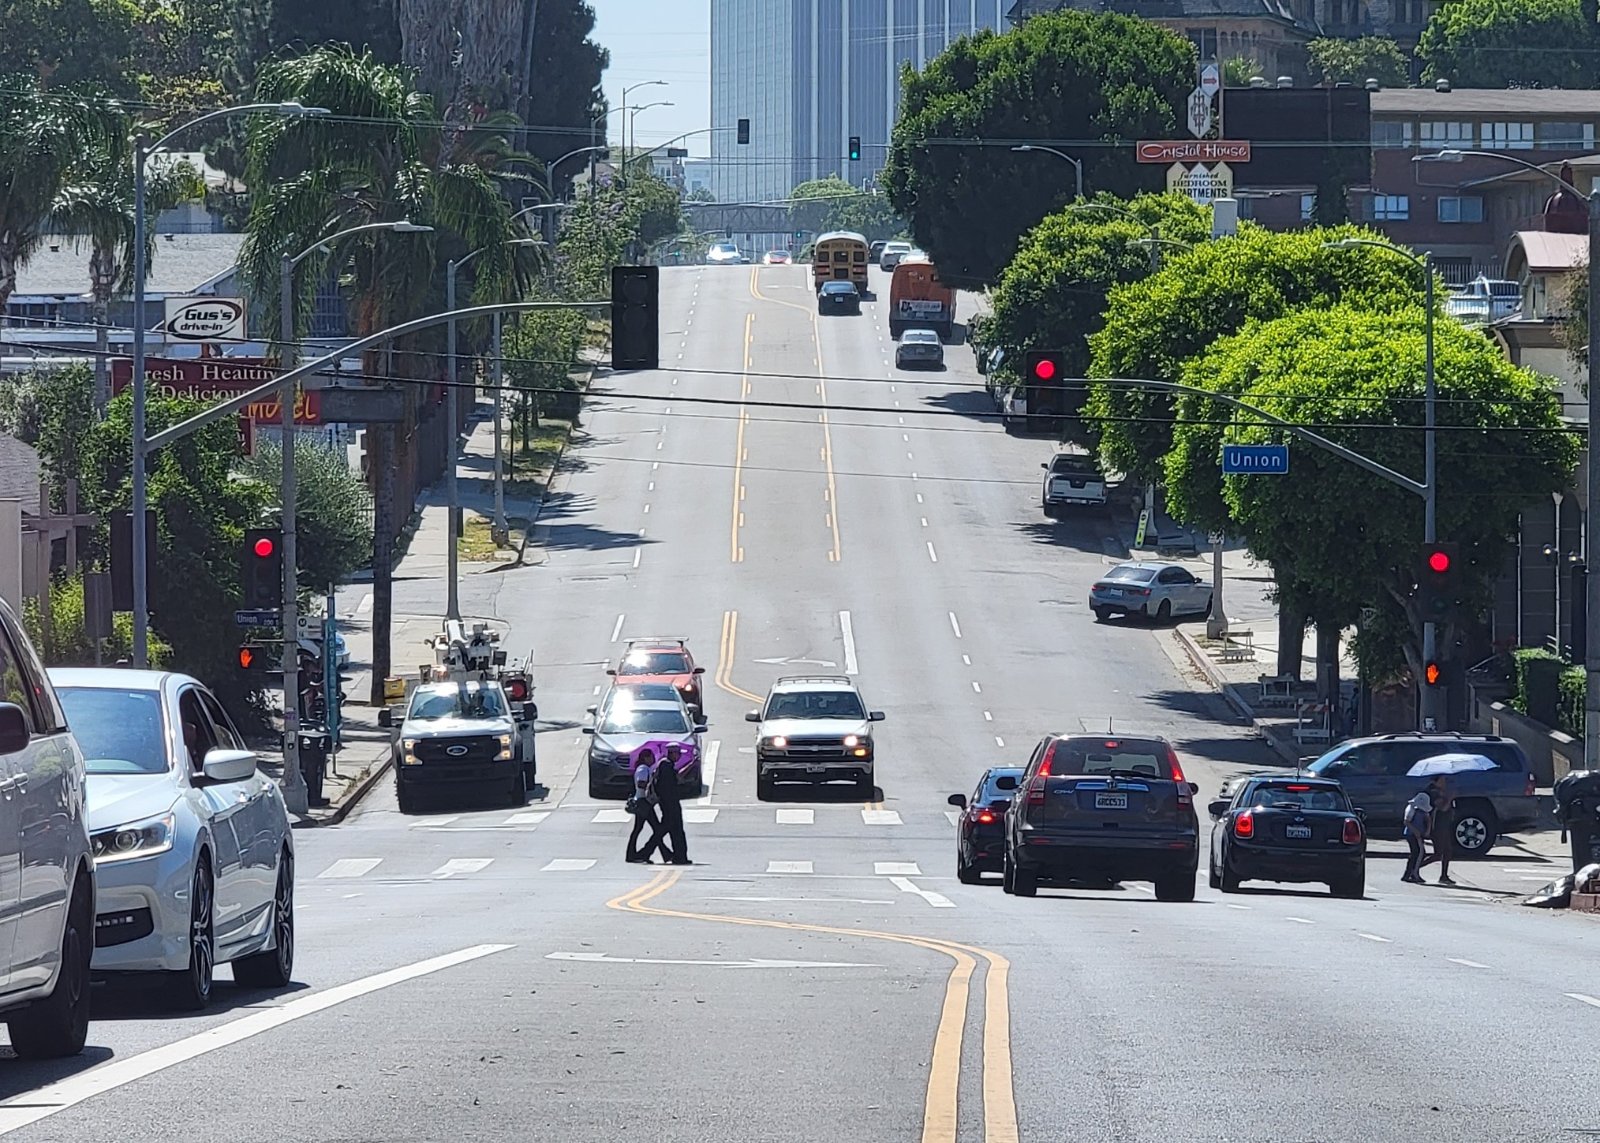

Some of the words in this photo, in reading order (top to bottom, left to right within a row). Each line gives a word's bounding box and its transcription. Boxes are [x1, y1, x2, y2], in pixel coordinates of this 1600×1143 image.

[1141, 144, 1201, 158] Crystal
[1203, 143, 1247, 158] House
[1178, 171, 1220, 182] furnished
[184, 308, 233, 321] Gus's
[180, 322, 223, 331] drive-in
[247, 396, 317, 419] MOEL
[1230, 452, 1281, 467] Union
[237, 614, 258, 623] Union
